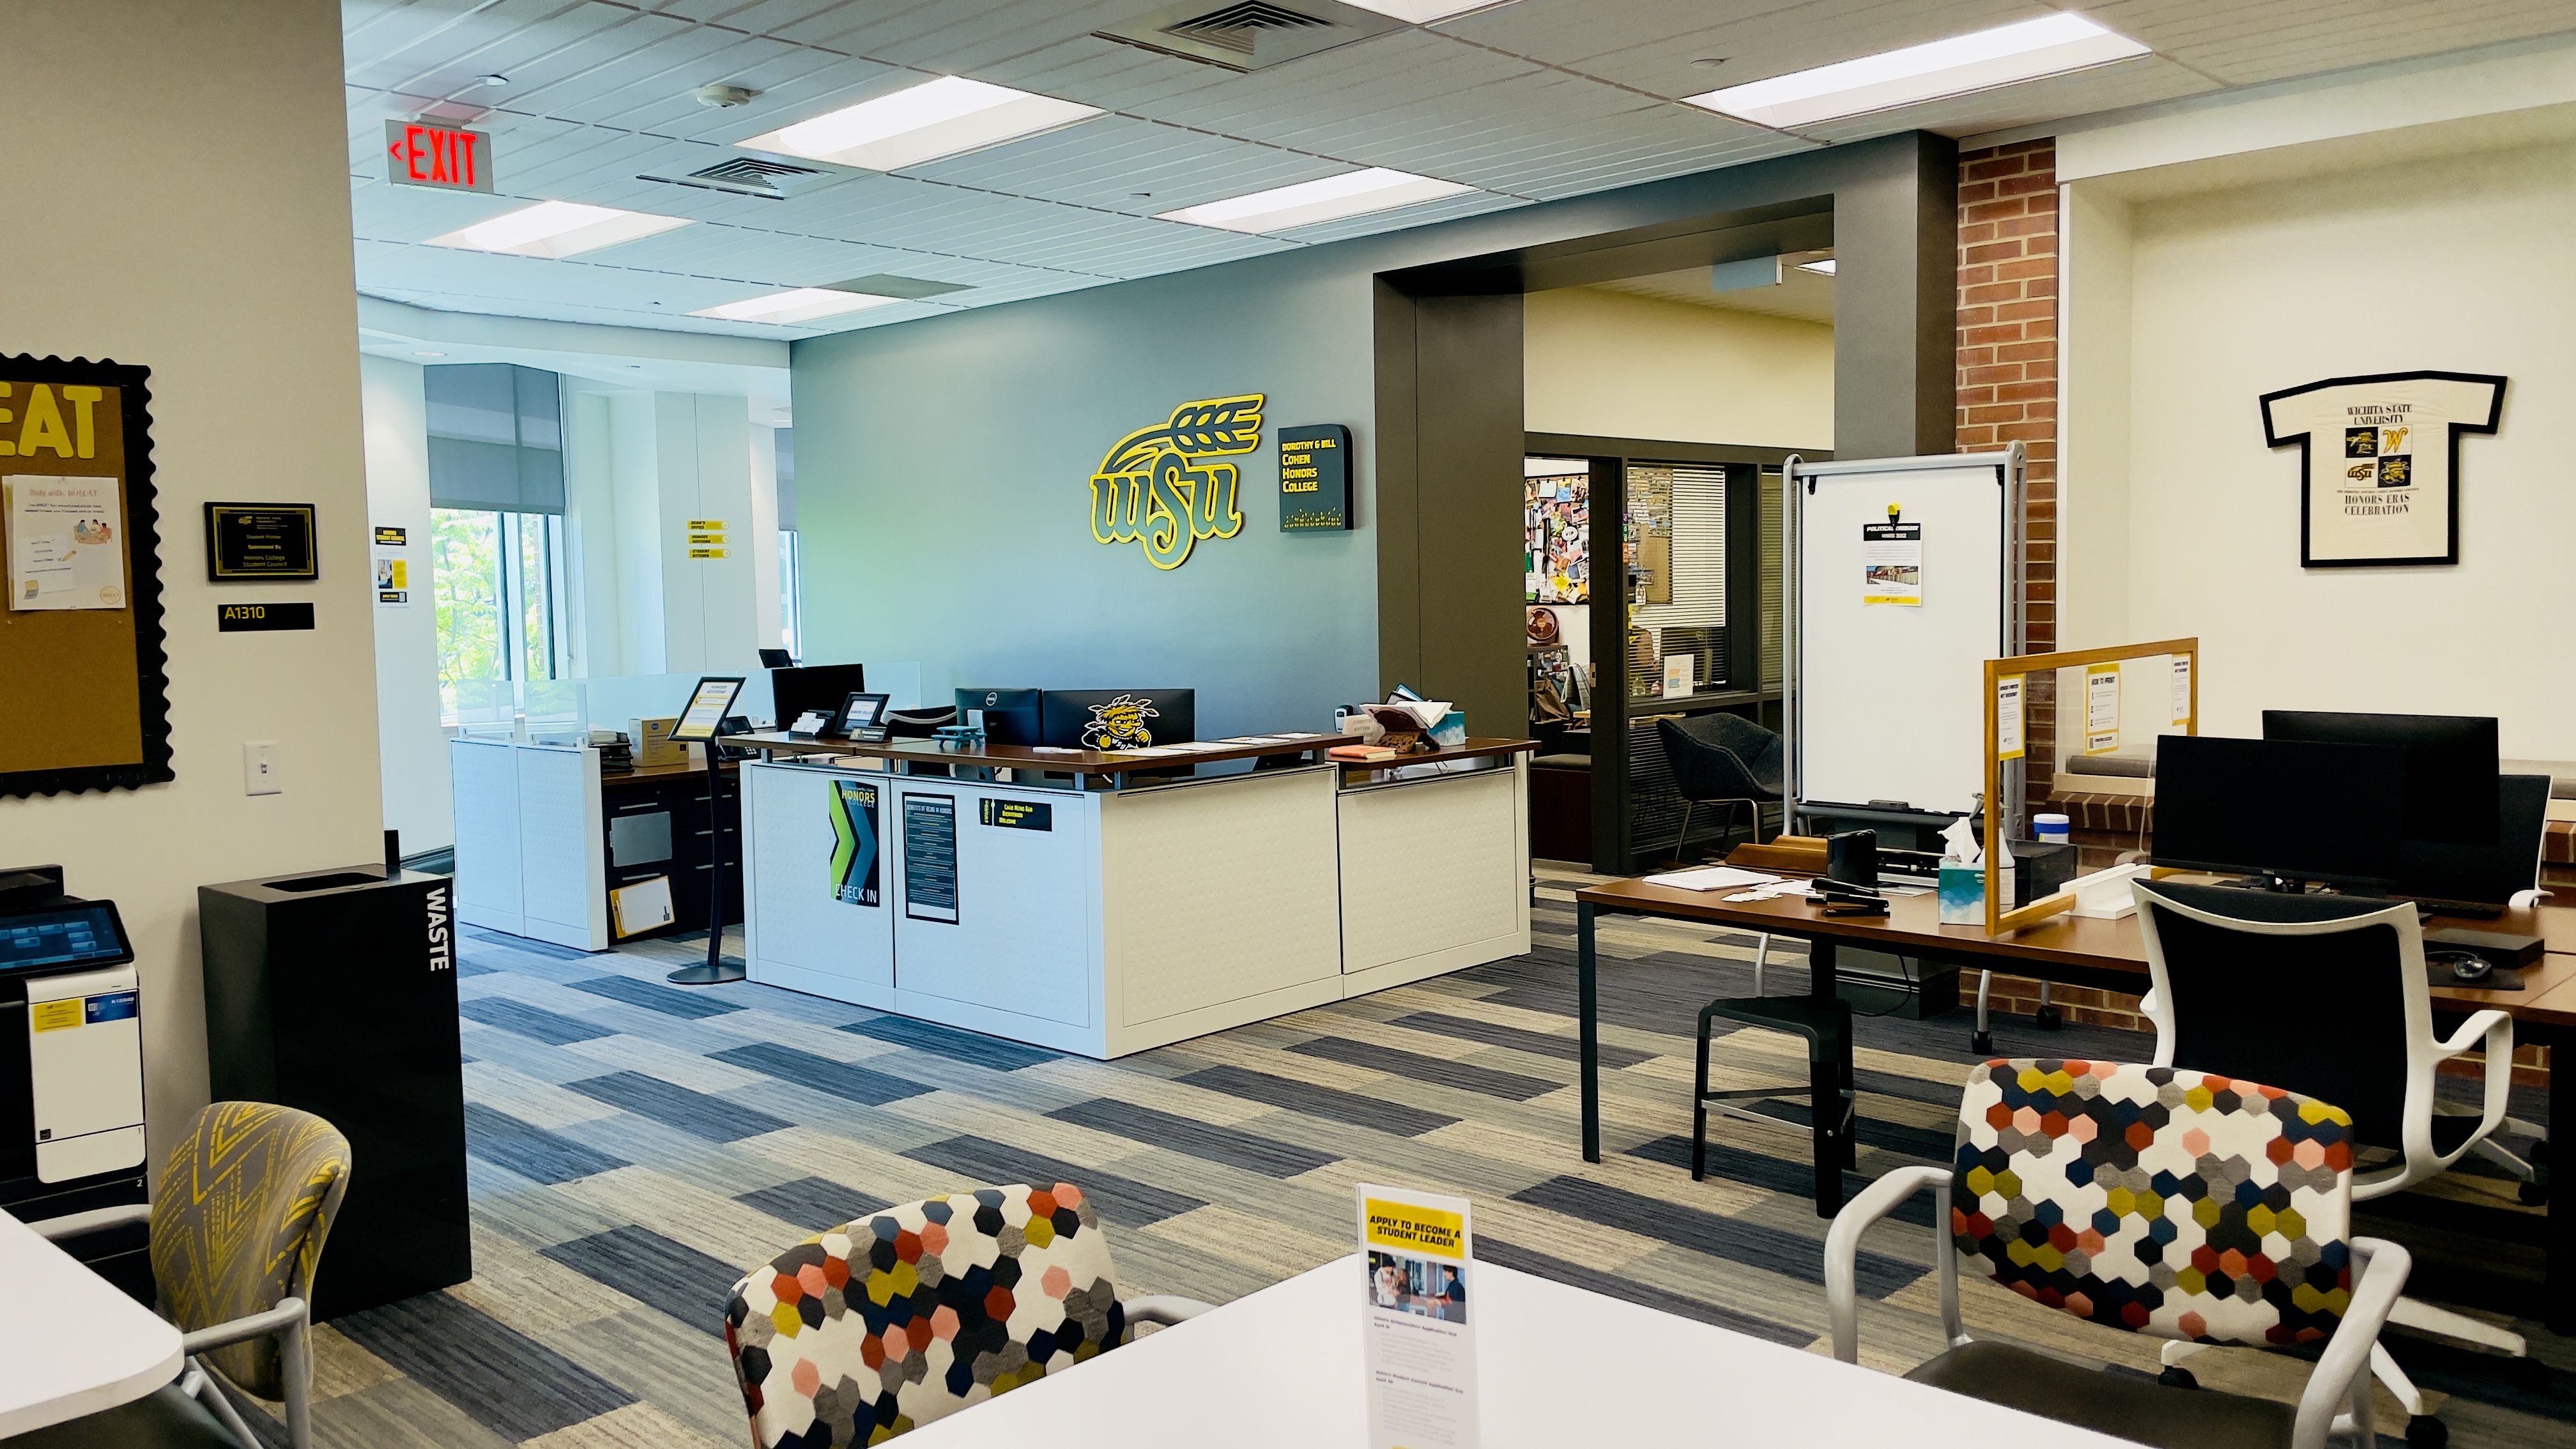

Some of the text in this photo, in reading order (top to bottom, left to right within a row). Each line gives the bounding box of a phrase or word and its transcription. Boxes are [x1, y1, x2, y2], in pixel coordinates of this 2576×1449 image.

[404, 125, 477, 187] EXIT
[2348, 404, 2412, 415] WICHITA STATE
[2354, 414, 2404, 425] UNIVERSITY
[1282, 439, 1337, 451] DOROTHY & BILL
[2382, 427, 2408, 453] W
[2345, 493, 2410, 504] HONORS ERAS
[2345, 504, 2409, 516] CELEBRATION
[225, 606, 265, 619] A1310
[1112, 738, 1126, 749] WSU
[842, 790, 875, 802] HONORS
[836, 883, 877, 903] CHECK IN
[427, 887, 449, 971] WASTE
[137, 1179, 143, 1187] 2
[1370, 1215, 1460, 1239] APPLY TO BECOME A
[1377, 1226, 1455, 1247] STUDENT LEADER
